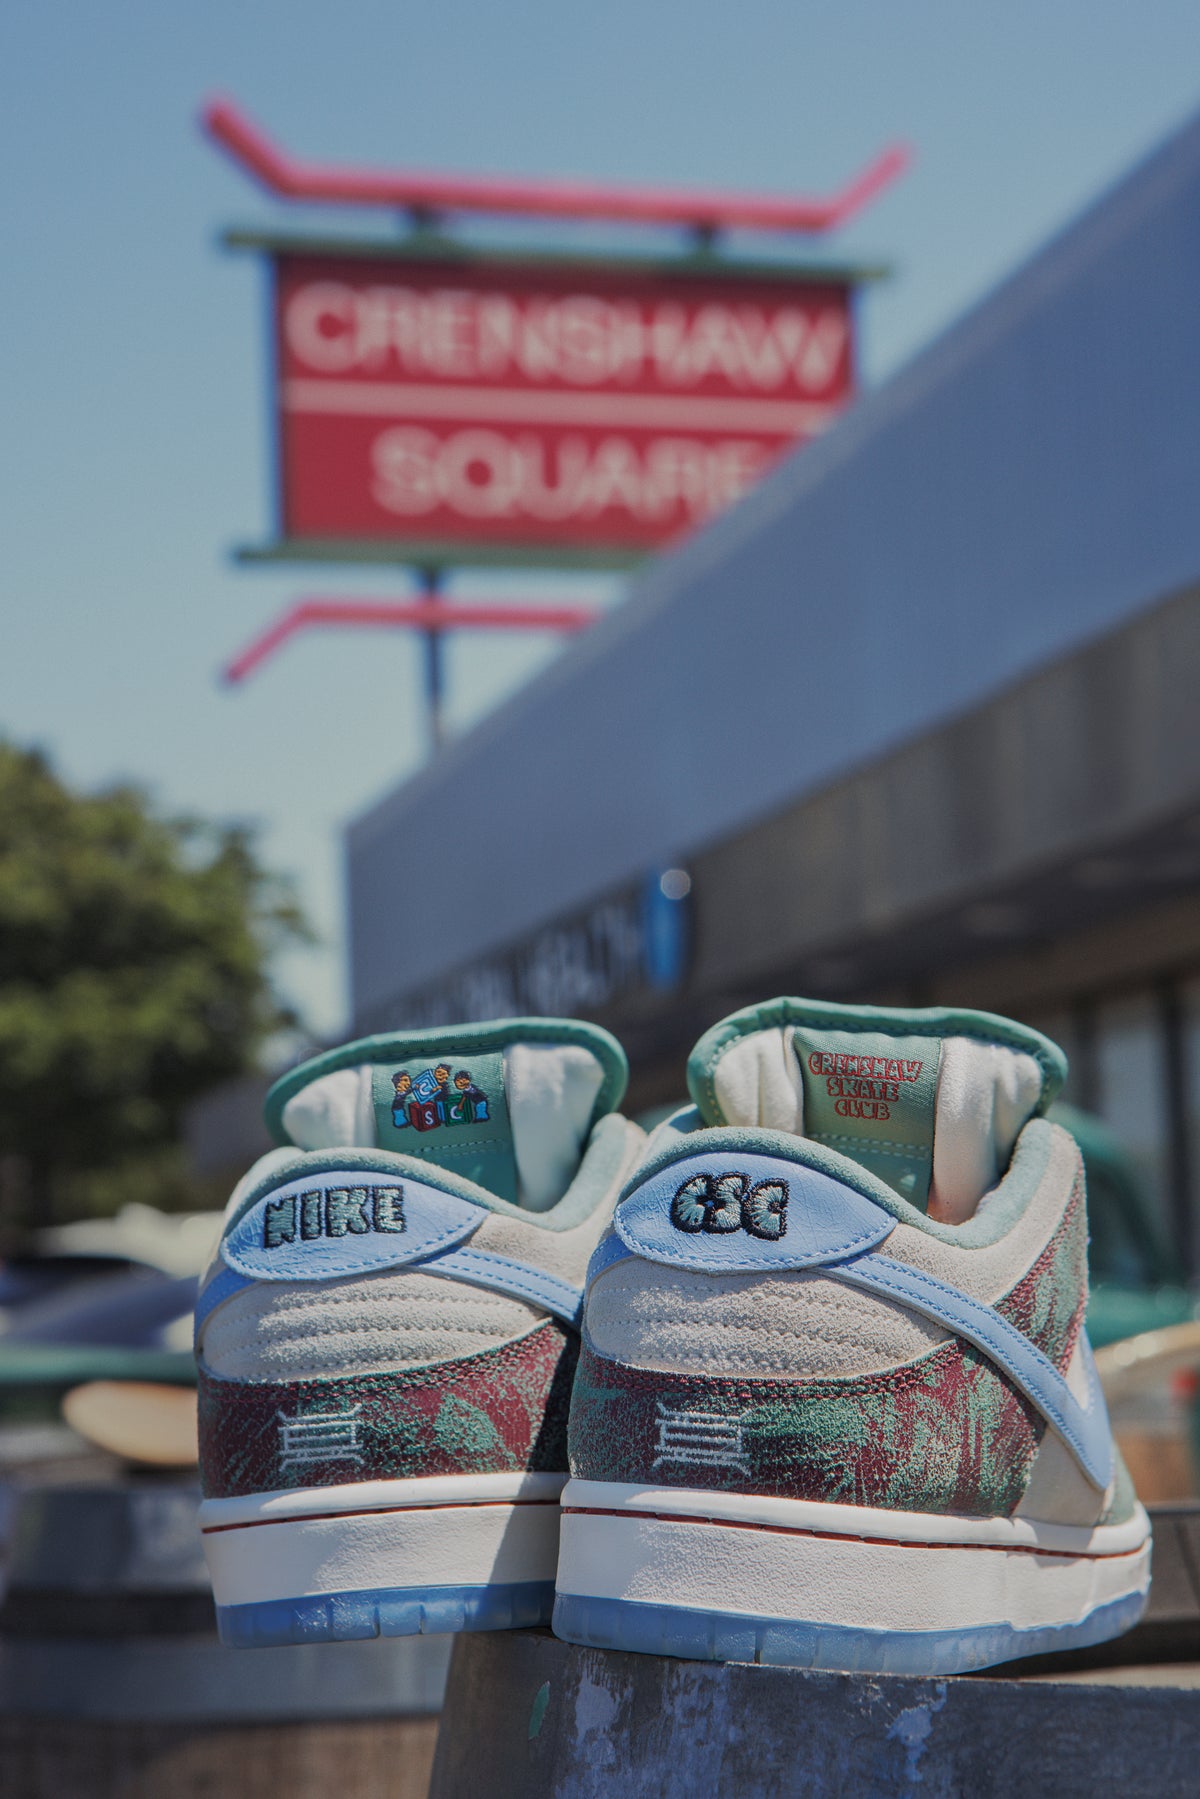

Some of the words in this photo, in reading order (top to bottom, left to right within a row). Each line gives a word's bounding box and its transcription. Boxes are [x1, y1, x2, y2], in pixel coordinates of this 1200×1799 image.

[286, 282, 848, 392] CRENSHAW
[808, 1051, 923, 1082] CRENSHAW
[826, 1076, 900, 1102] SKATE
[834, 1099, 890, 1120] CLUB
[264, 1184, 407, 1248] NIKE
